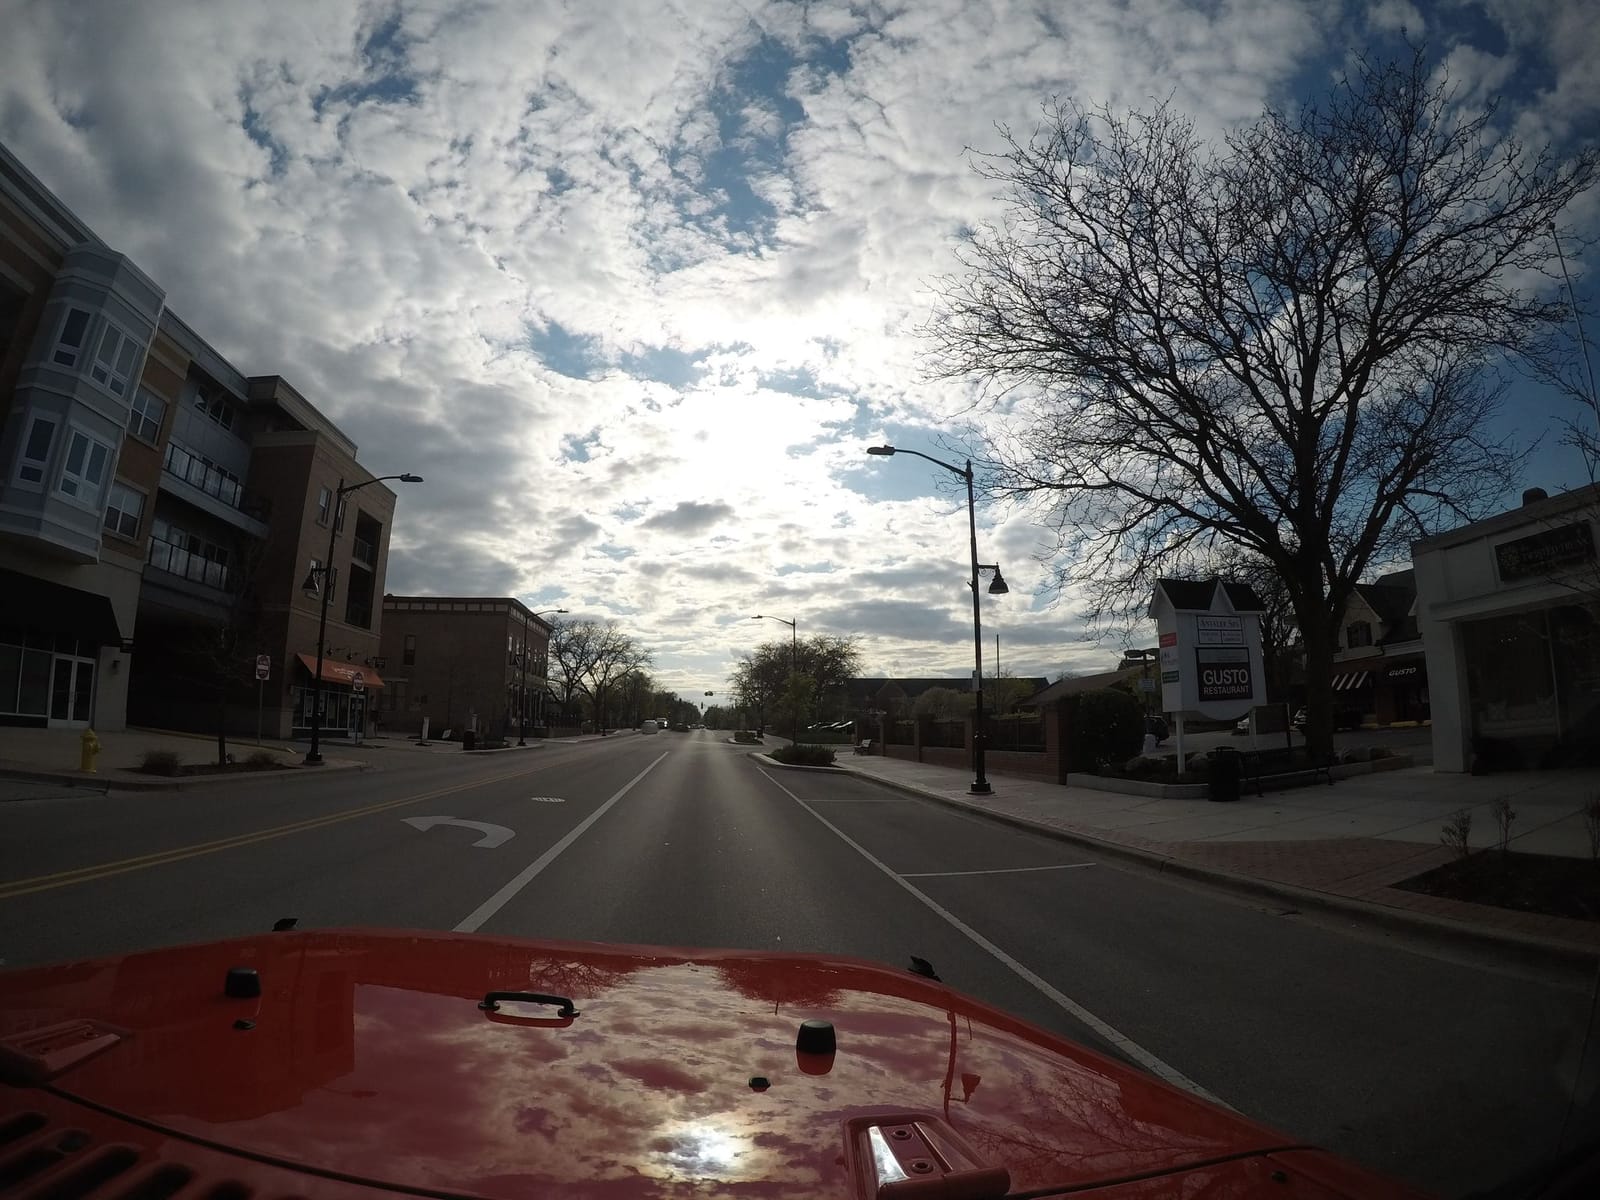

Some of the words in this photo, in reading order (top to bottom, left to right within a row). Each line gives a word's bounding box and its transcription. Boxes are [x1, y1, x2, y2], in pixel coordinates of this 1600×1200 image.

[1203, 669, 1249, 685] GUSTO
[1388, 667, 1417, 677] GUSTO
[1203, 685, 1249, 696] RESTAURANT
